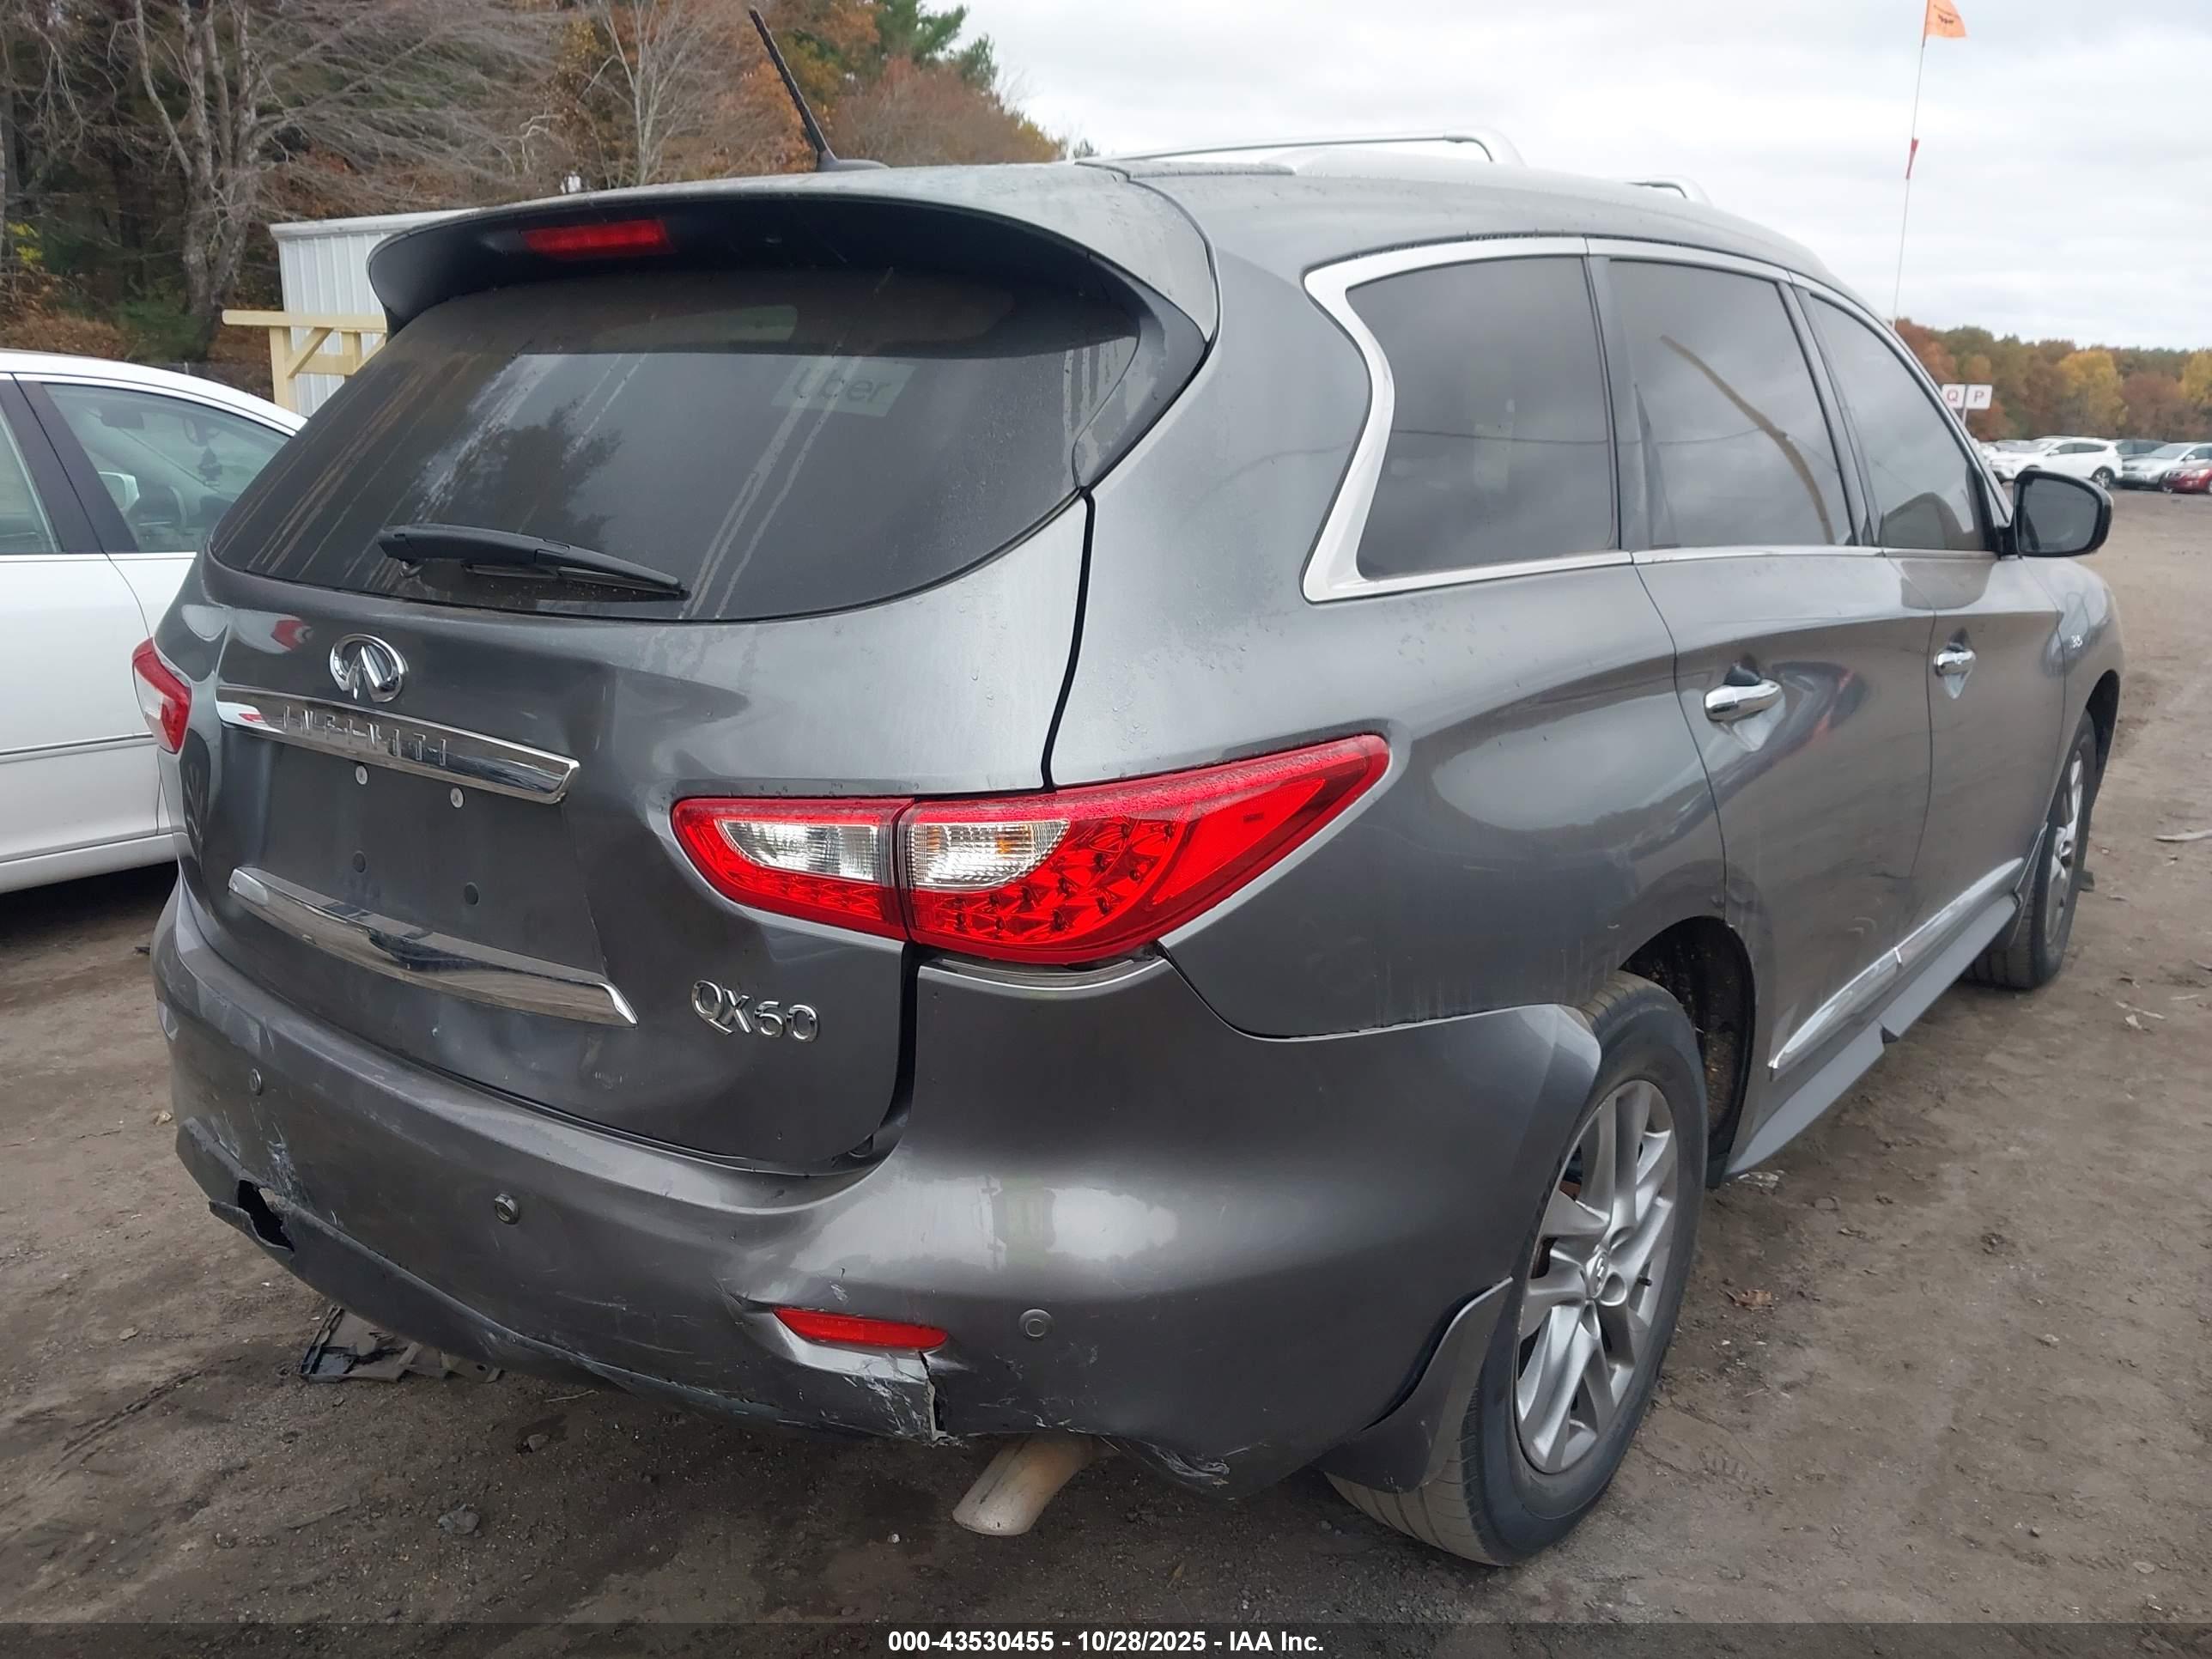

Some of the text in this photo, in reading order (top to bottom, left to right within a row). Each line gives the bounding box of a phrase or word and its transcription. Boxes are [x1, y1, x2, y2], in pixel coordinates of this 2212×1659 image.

[1947, 389, 1984, 403] Q P
[283, 706, 447, 767] INFINITI
[691, 979, 819, 1042] QX60
